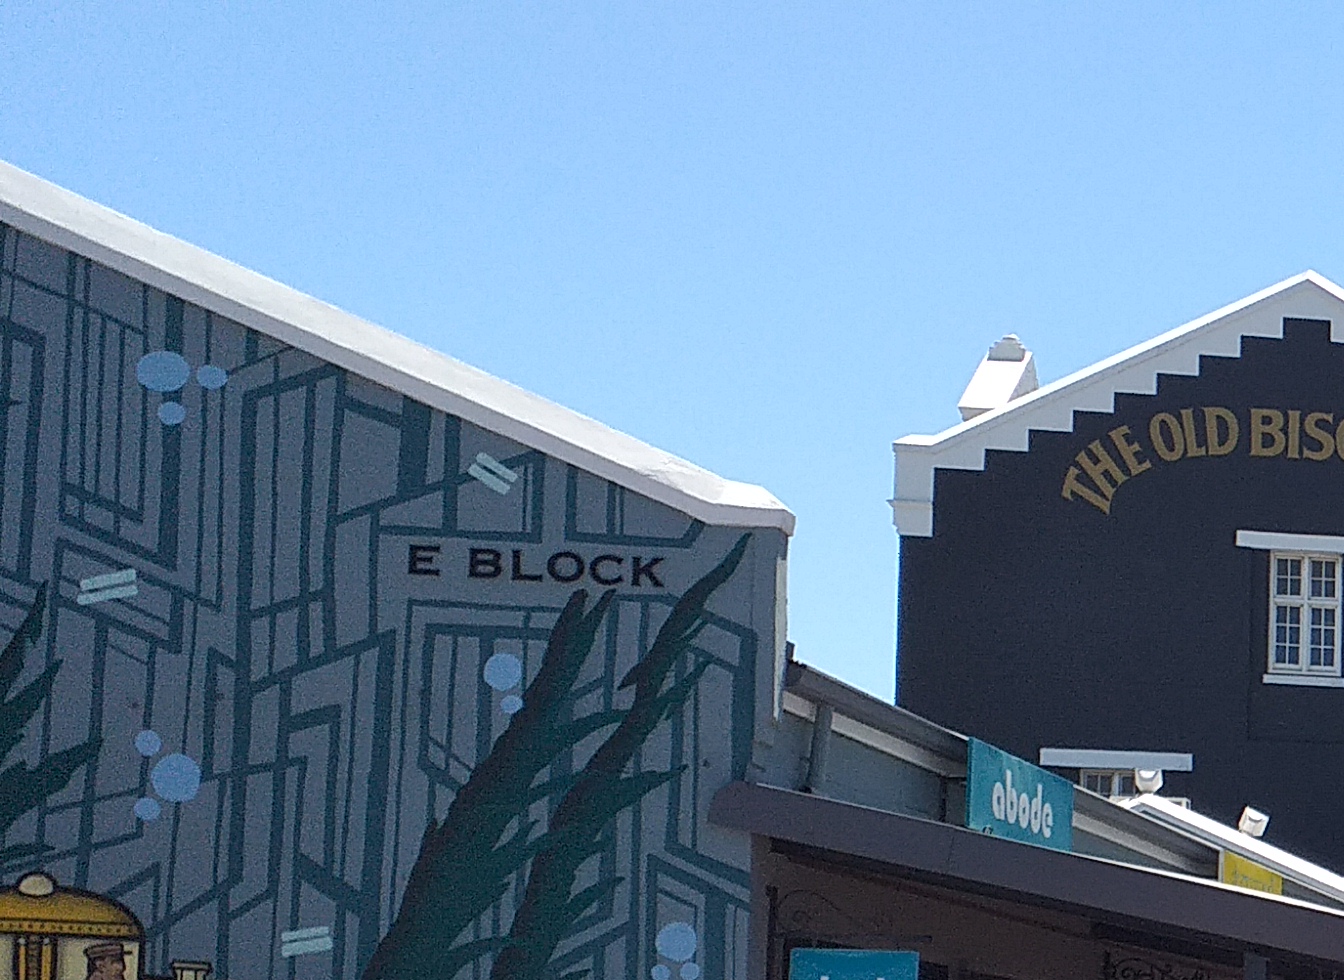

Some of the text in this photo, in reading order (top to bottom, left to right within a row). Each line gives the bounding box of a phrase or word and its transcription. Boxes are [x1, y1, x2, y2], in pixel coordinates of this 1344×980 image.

[1062, 425, 1152, 515] THE
[1149, 406, 1240, 461] OLD
[408, 544, 665, 587] E BLOCK
[992, 768, 1053, 838] abode
